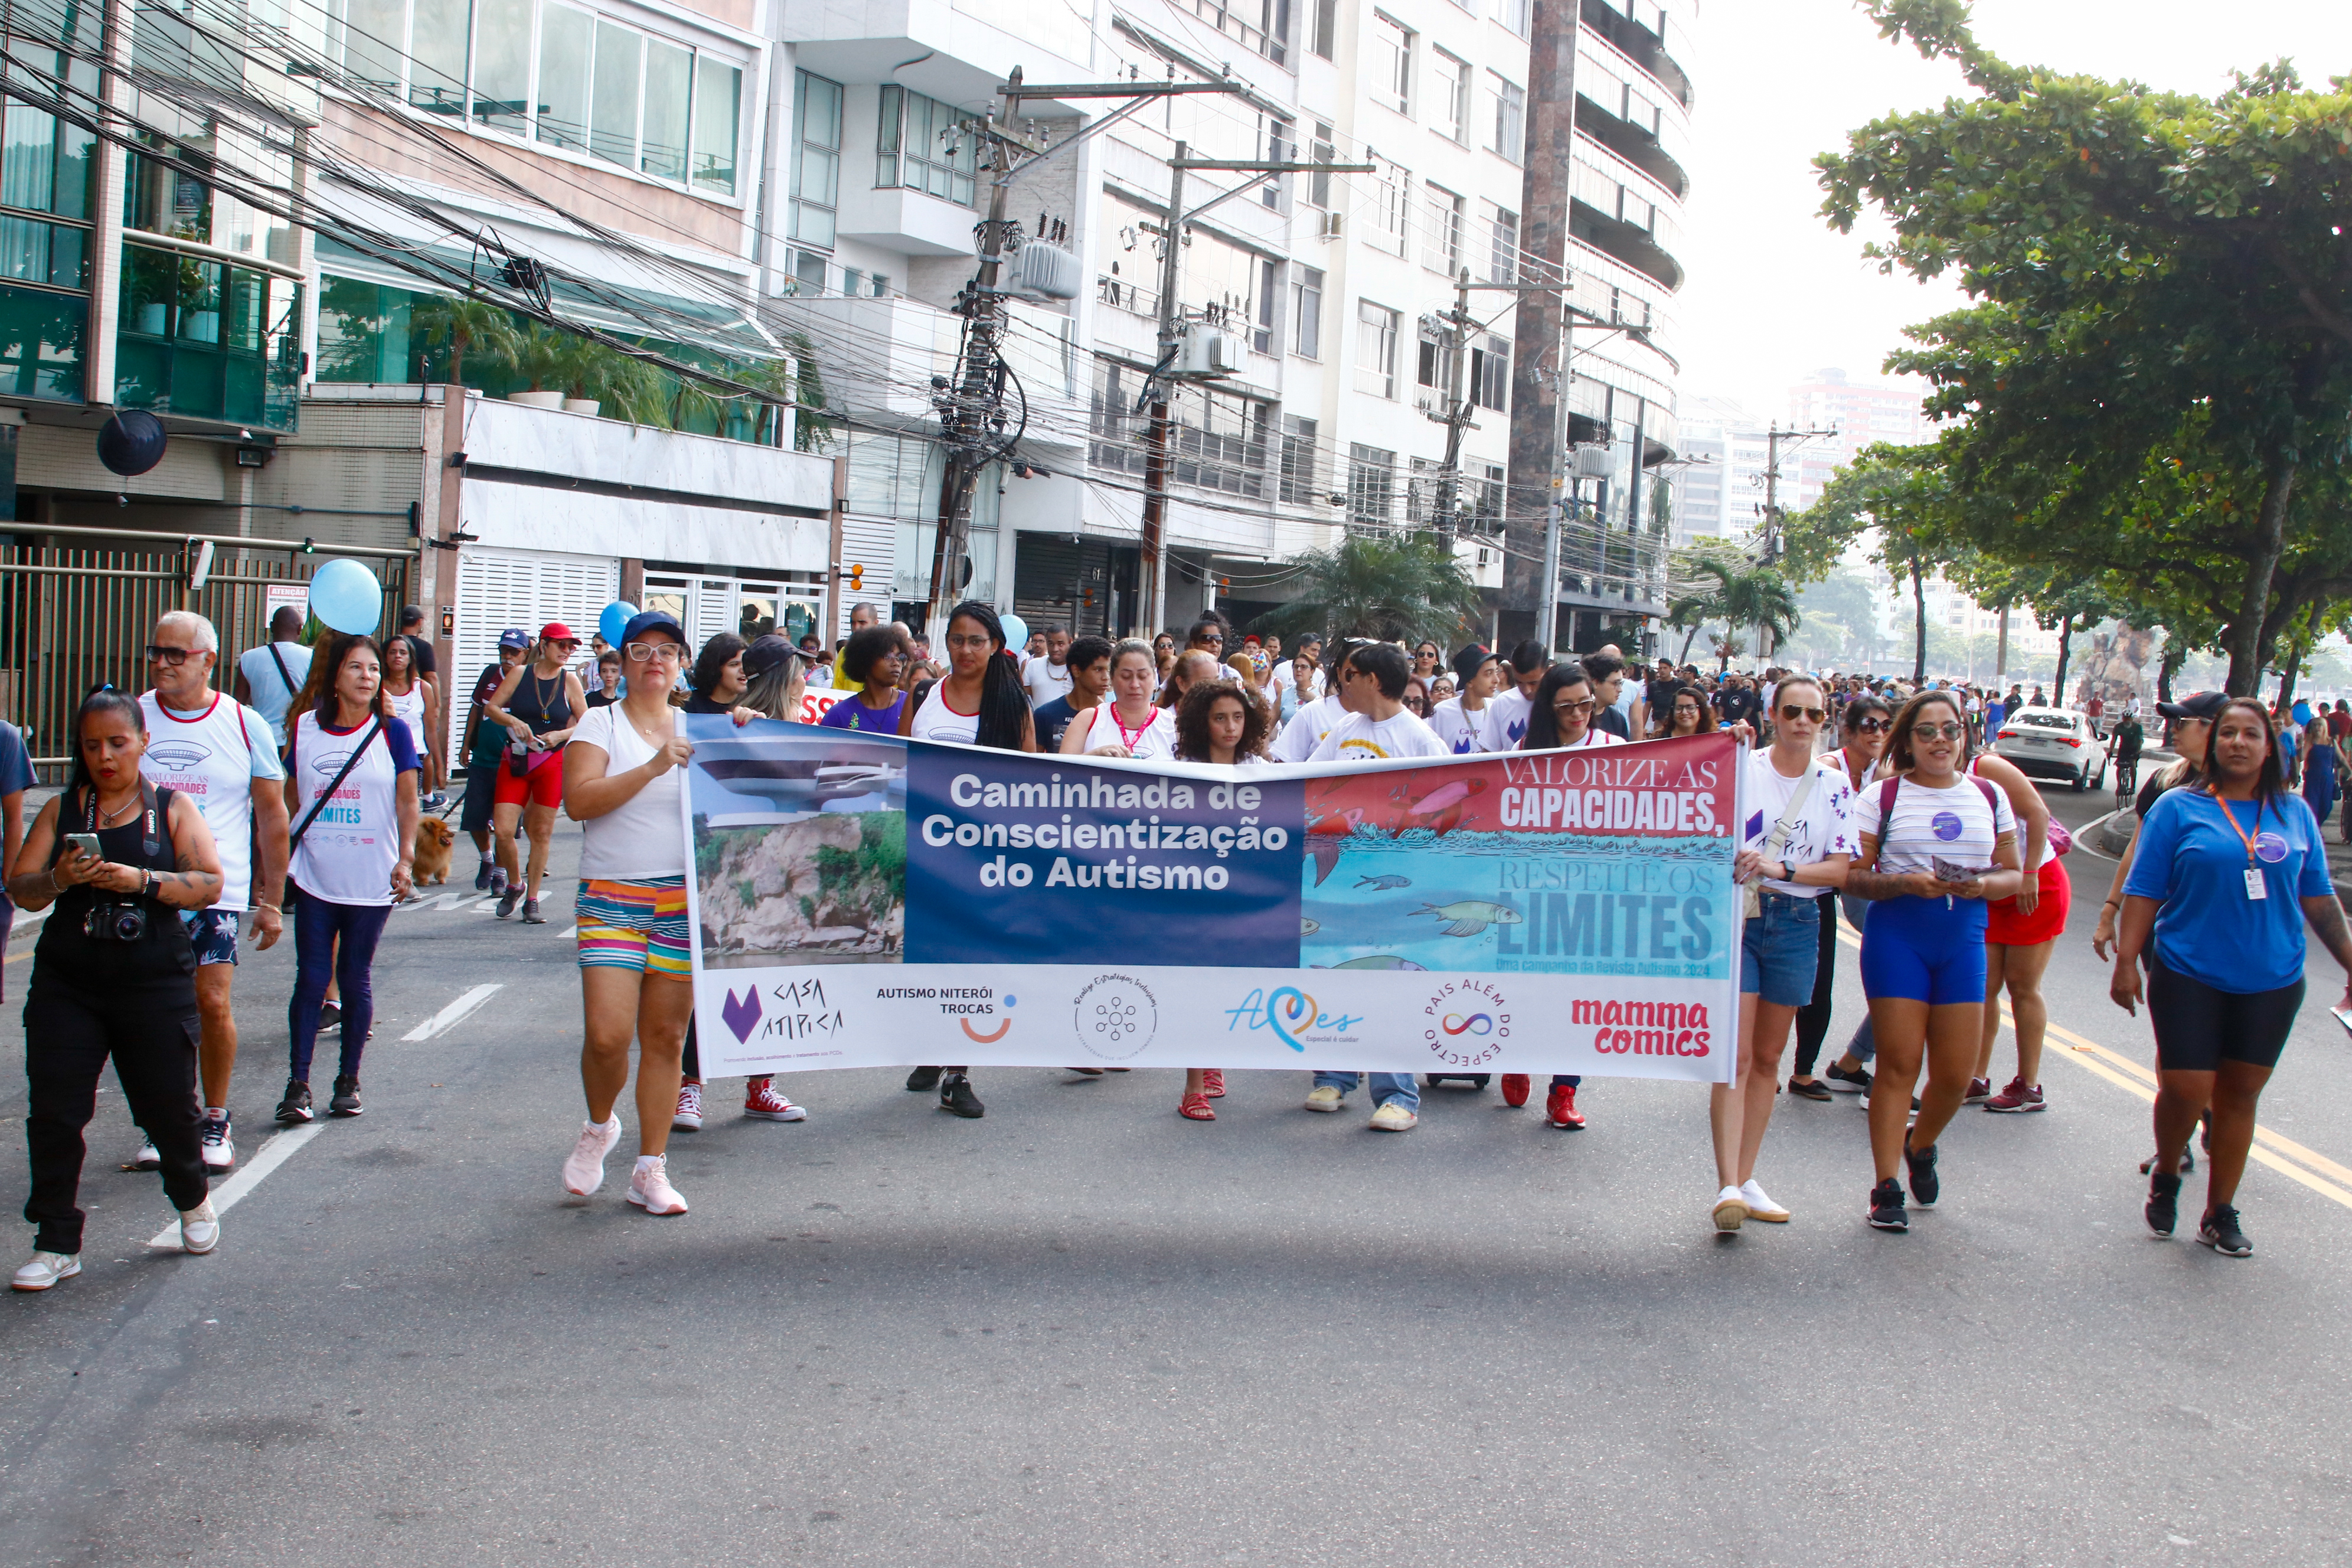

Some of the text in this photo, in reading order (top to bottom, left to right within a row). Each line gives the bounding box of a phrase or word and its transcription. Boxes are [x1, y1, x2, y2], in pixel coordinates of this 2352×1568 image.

[1093, 567, 1100, 580] 61
[272, 588, 306, 597] ATENÇÃO
[982, 581, 993, 597] 29
[146, 772, 209, 783] VALORIZE AS
[1501, 756, 1717, 789] VALORIZE AS
[950, 773, 1262, 811] Caminhada de
[86, 806, 94, 831] DIGITAL
[148, 809, 156, 834] Canon
[1500, 787, 1725, 838] CAPACIDADES,
[922, 814, 1288, 857] Conscientização
[979, 855, 1230, 890] do Autismo
[1500, 861, 1713, 894] RESPEITE OS
[1497, 891, 1713, 961] LIMITES
[1496, 958, 1710, 976] Uma campanha da Revista Autismo 2024
[773, 978, 826, 1008] CASA
[877, 986, 992, 998] AUTISMO NITERÓI
[1074, 983, 1093, 1005] Realize
[1134, 978, 1157, 1008] Inclusivas
[940, 1004, 994, 1014] TROCAS
[1425, 979, 1510, 1066] PAIS ALÉM DO ESPECTRO
[1572, 999, 1710, 1031] mamma
[1595, 1027, 1710, 1057] comics
